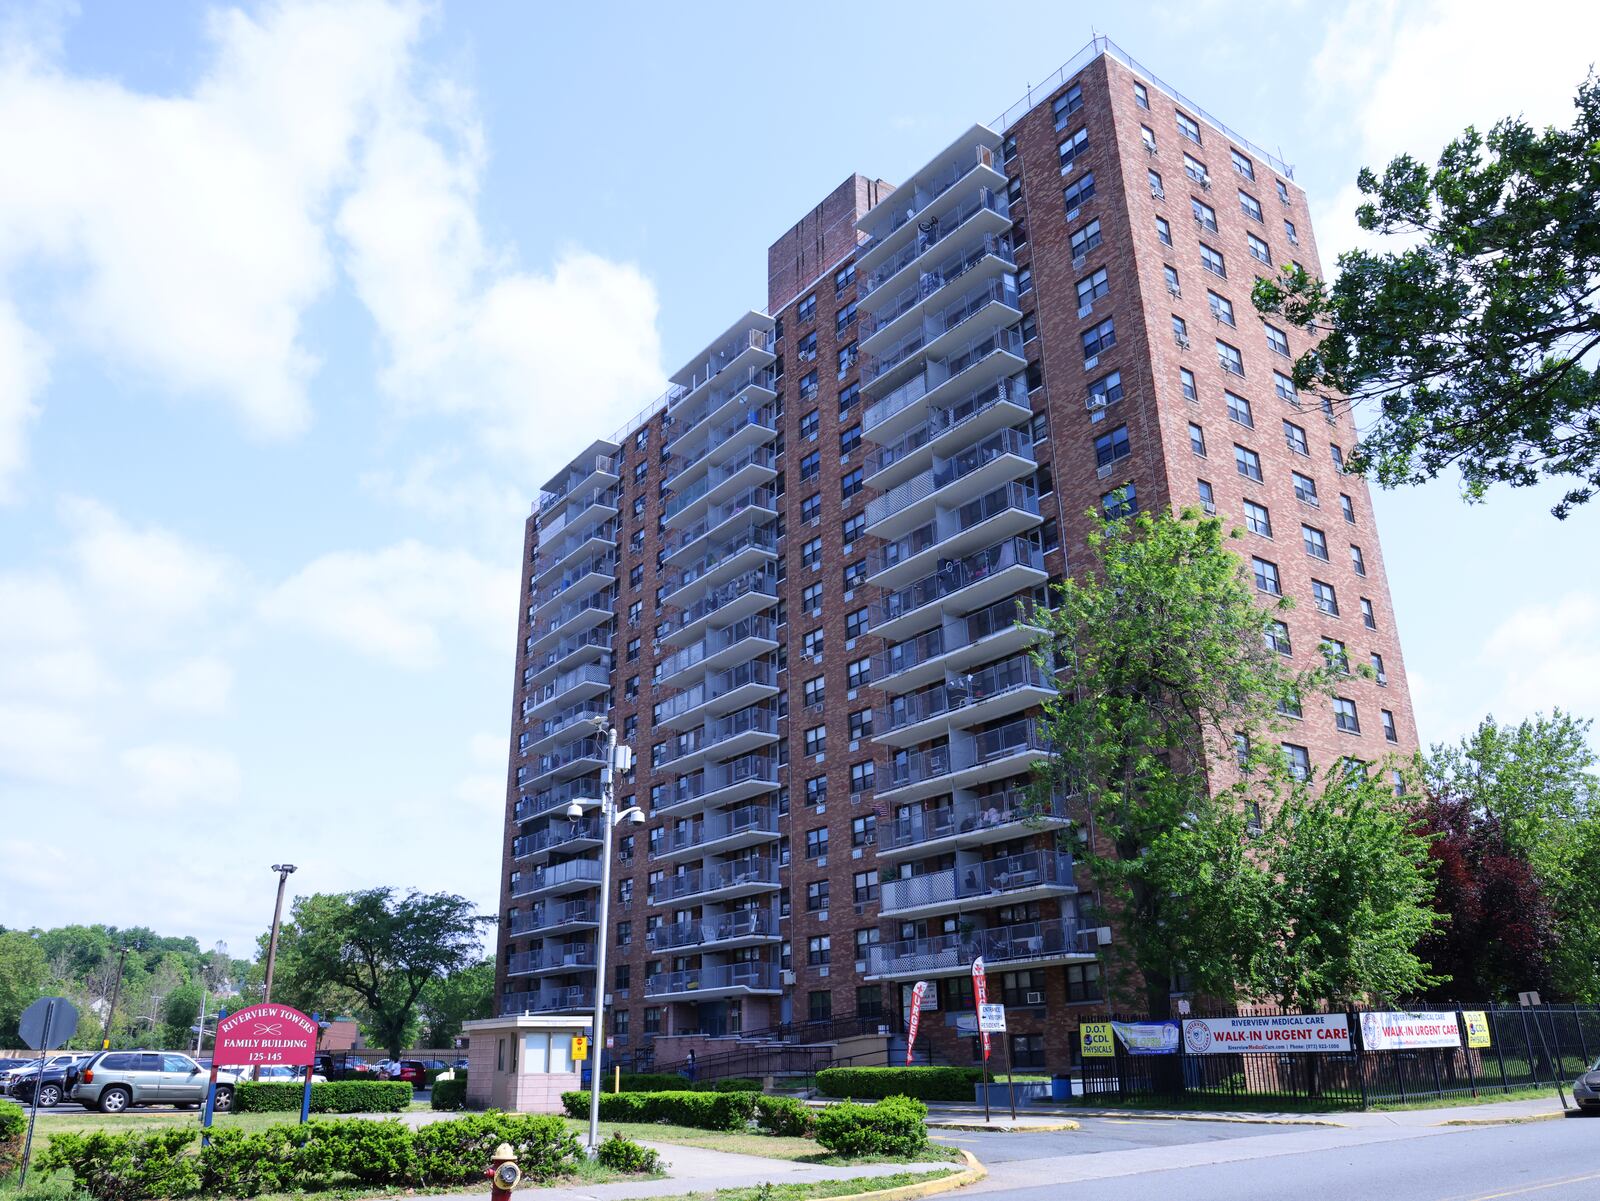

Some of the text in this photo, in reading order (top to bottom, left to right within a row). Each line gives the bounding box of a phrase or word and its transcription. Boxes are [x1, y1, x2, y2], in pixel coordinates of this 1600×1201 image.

[221, 1008, 315, 1034] RIVERVIEW TOWERS
[1086, 1025, 1106, 1034] D.O.T
[1382, 1024, 1459, 1037] WALK-IN URGENT CARE
[1093, 1035, 1110, 1043] CDL
[1213, 1028, 1348, 1042] WALK-IN URGENT CARE
[223, 1039, 308, 1048] FAMILY BUILDING
[1083, 1045, 1112, 1053] PHYSICALS
[249, 1052, 282, 1061] 125-145
